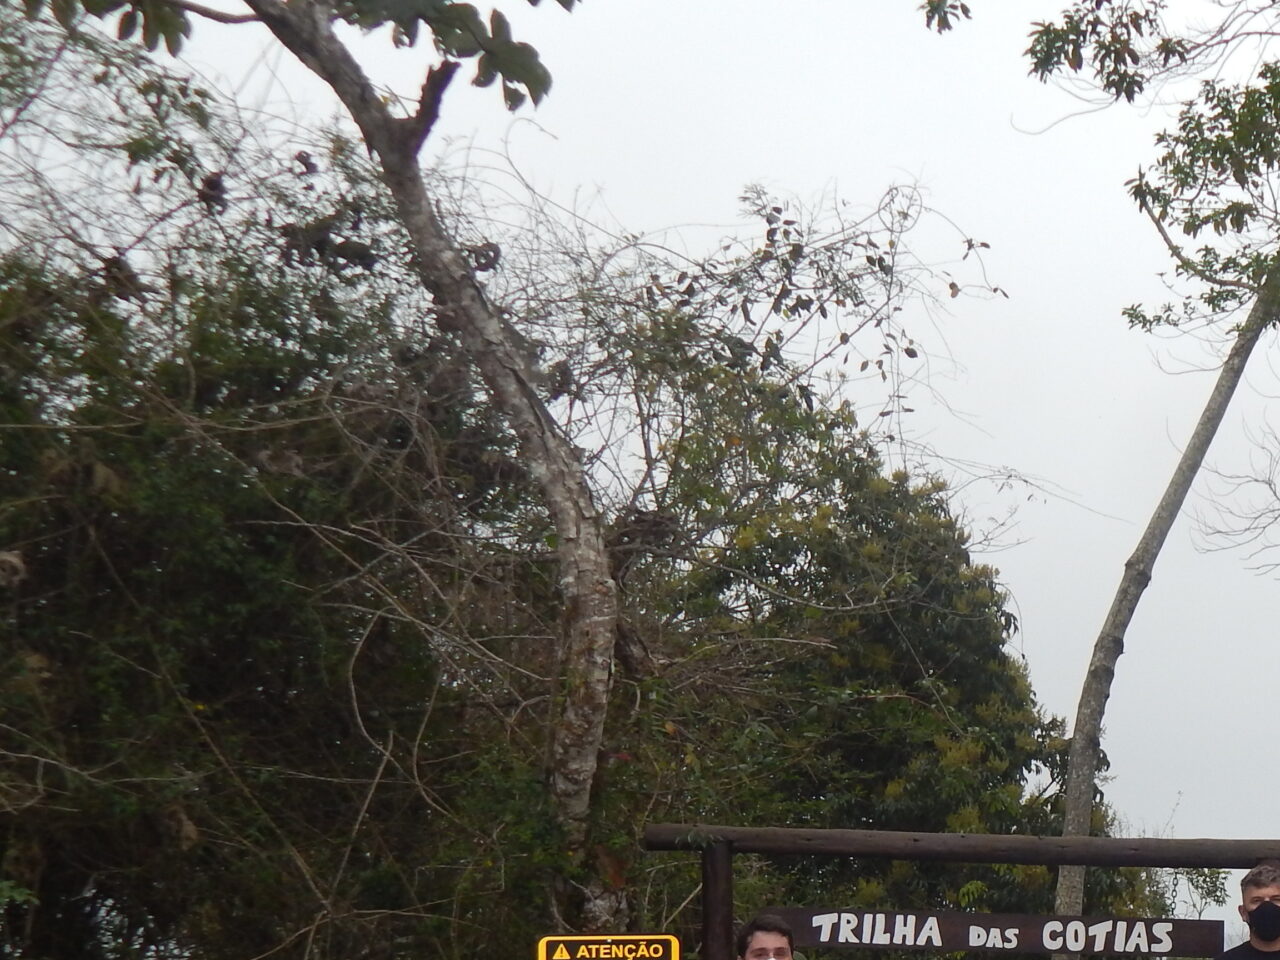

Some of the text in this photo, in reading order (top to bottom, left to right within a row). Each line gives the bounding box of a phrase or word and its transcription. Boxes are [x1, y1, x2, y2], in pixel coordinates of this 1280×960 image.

[812, 912, 1173, 953] TRILHA DAS COTIAS
[576, 941, 664, 960] ATENÇÃO
